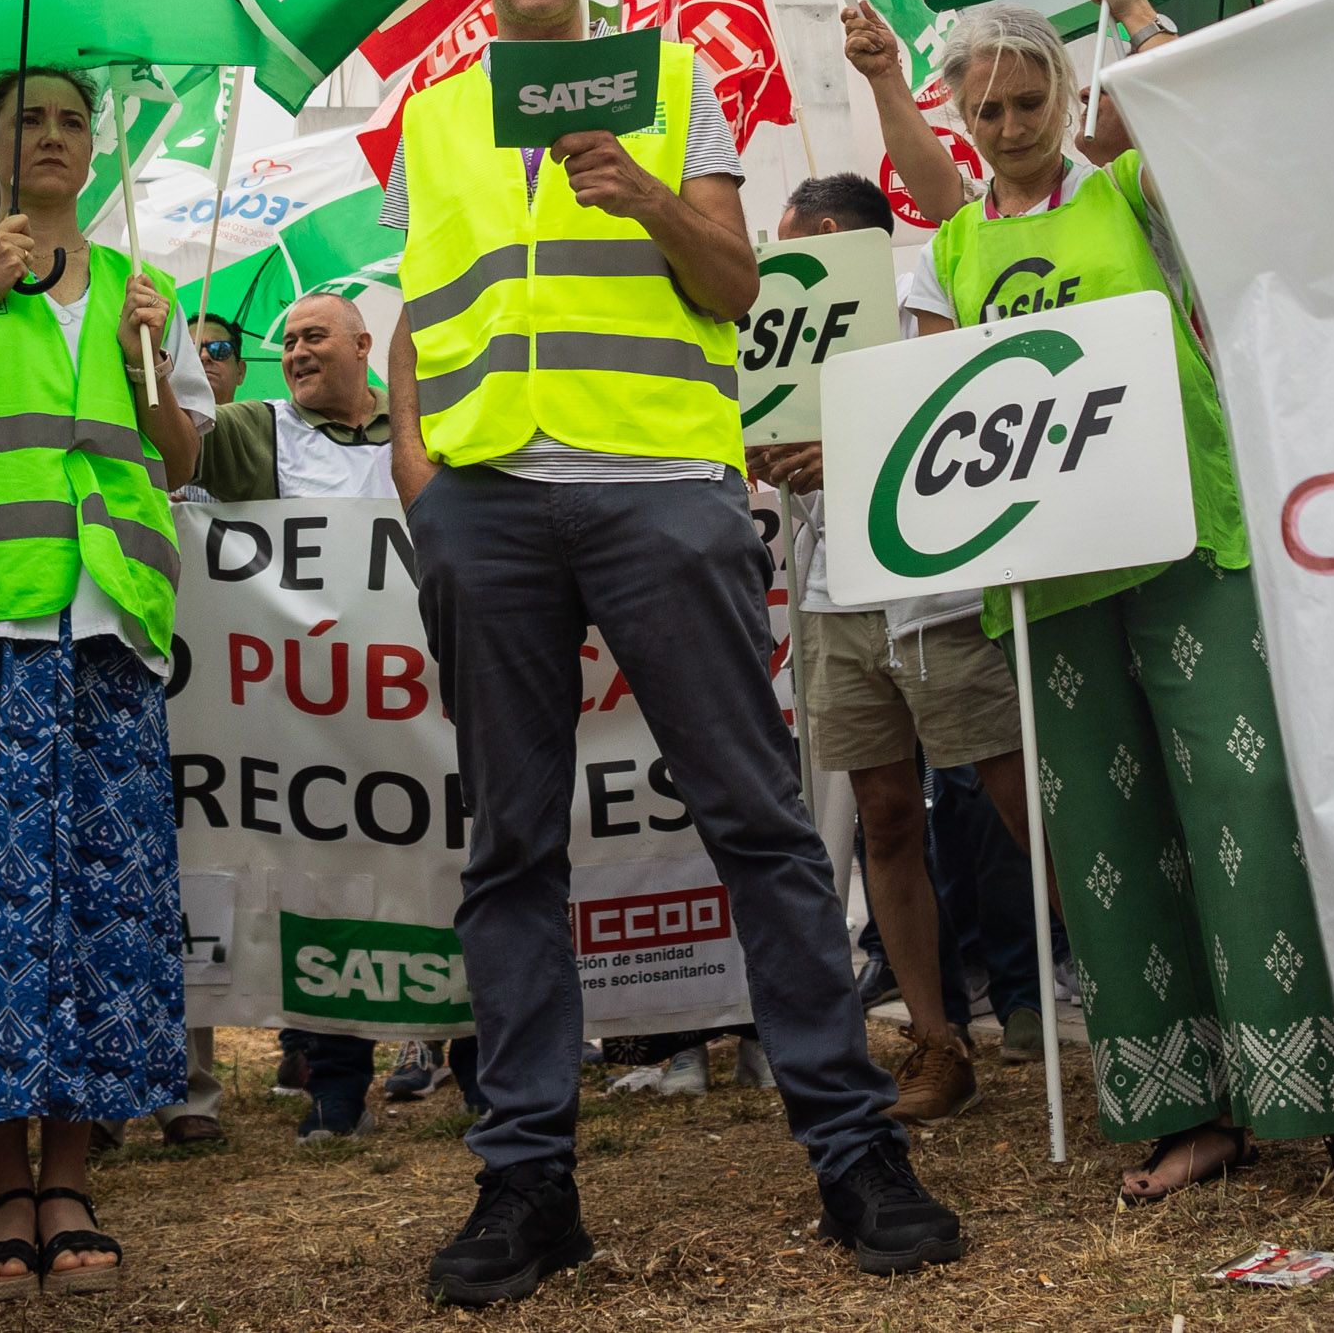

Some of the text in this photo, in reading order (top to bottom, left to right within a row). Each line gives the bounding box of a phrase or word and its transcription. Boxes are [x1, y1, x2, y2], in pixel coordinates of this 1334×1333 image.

[518, 70, 637, 116] SATSE
[206, 515, 328, 592] DE
[590, 899, 722, 943] CCOO
[611, 962, 726, 987] sociosanitarios
[612, 951, 630, 968] de
[634, 945, 695, 966] sanidad
